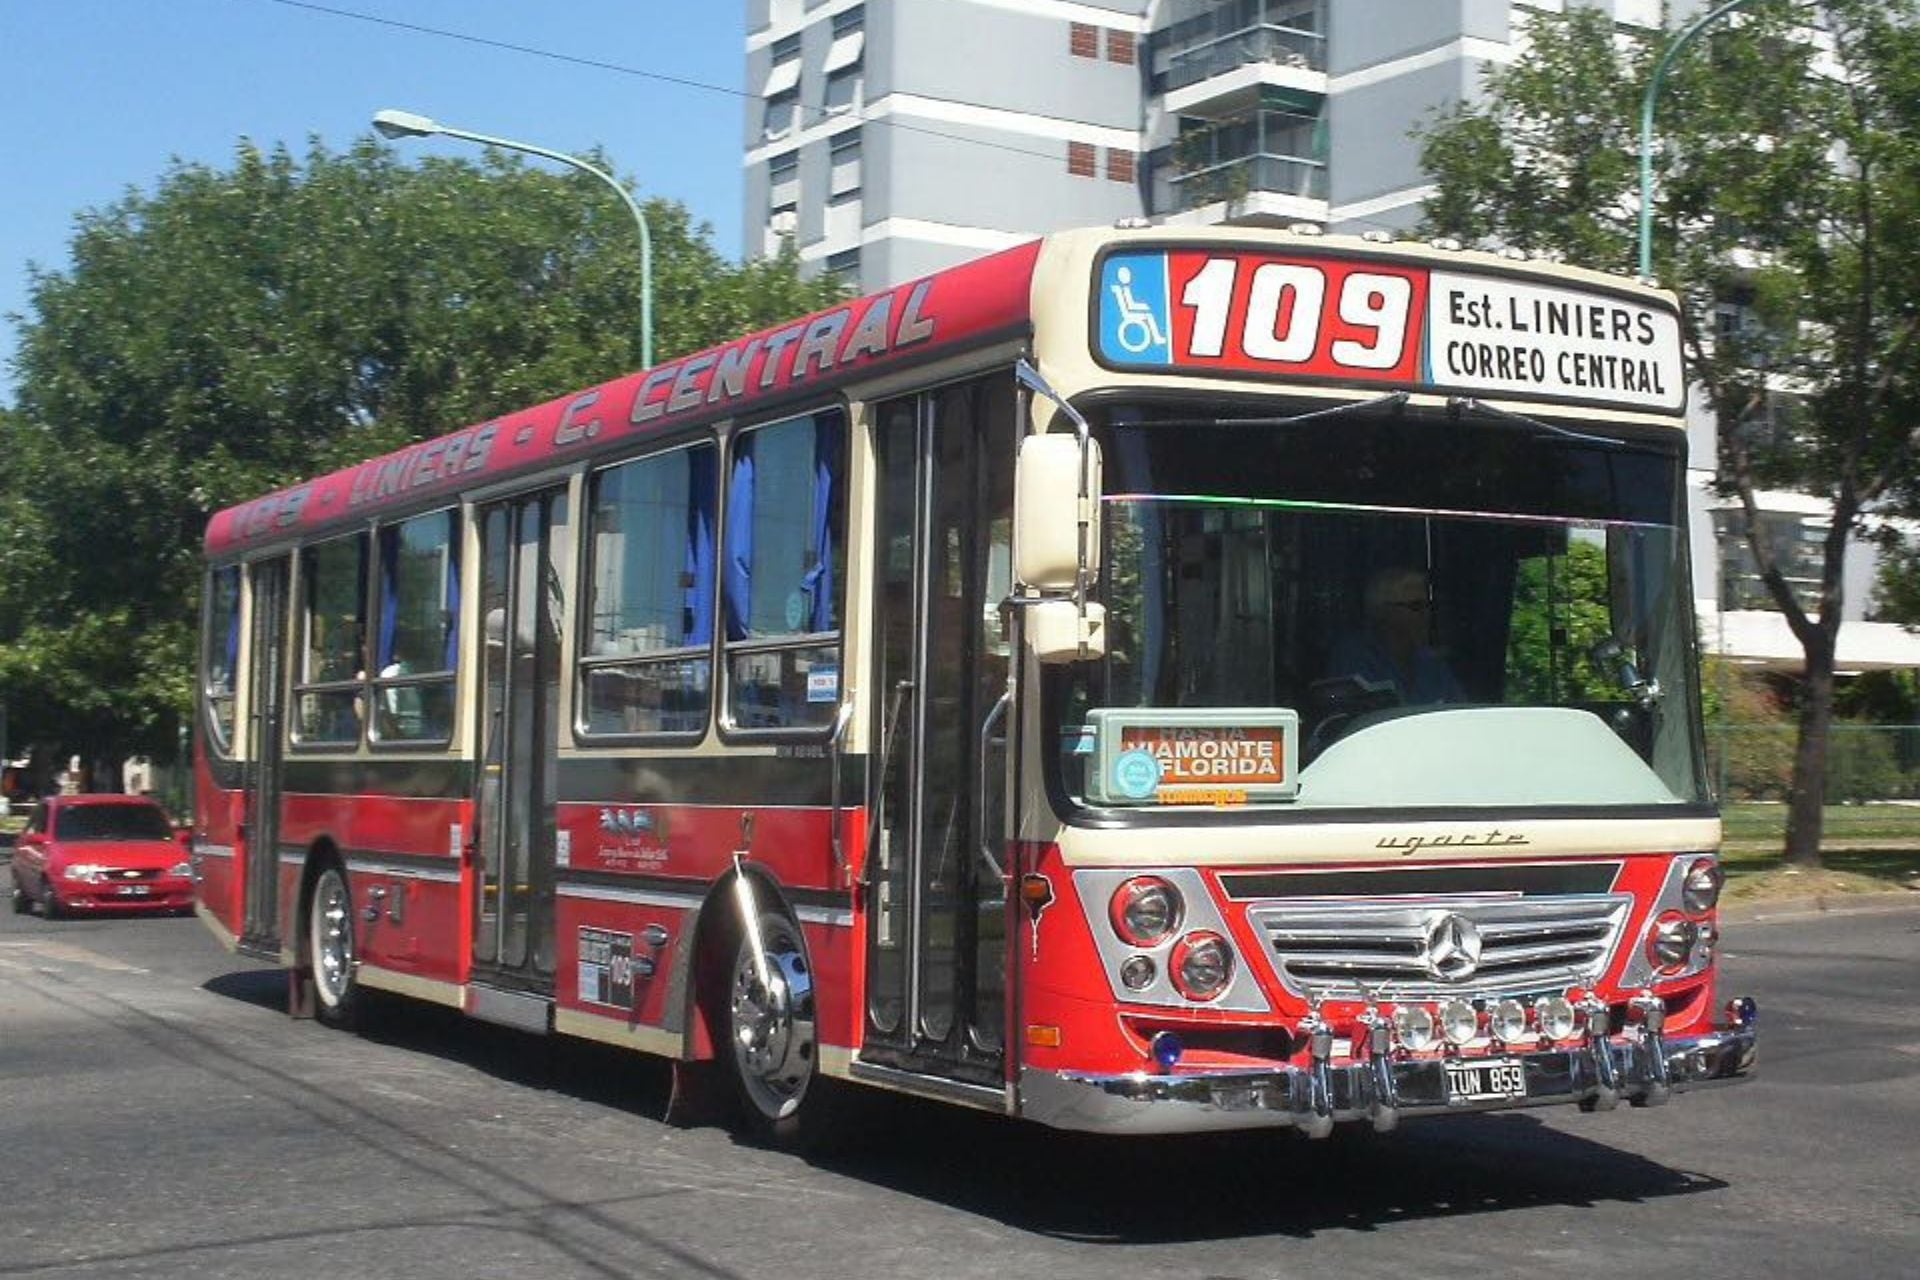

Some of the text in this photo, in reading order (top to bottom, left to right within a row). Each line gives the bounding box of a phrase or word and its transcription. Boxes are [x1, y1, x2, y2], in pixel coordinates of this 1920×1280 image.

[1181, 257, 1412, 369] 109
[1450, 291, 1656, 345] Est. LINIERS
[630, 280, 934, 424] CENTRAL
[1448, 341, 1665, 395] CORREO CENTRAL
[1160, 759, 1276, 776] FLORIDA
[1376, 829, 1531, 856] ugarte
[1489, 1065, 1523, 1093] 859
